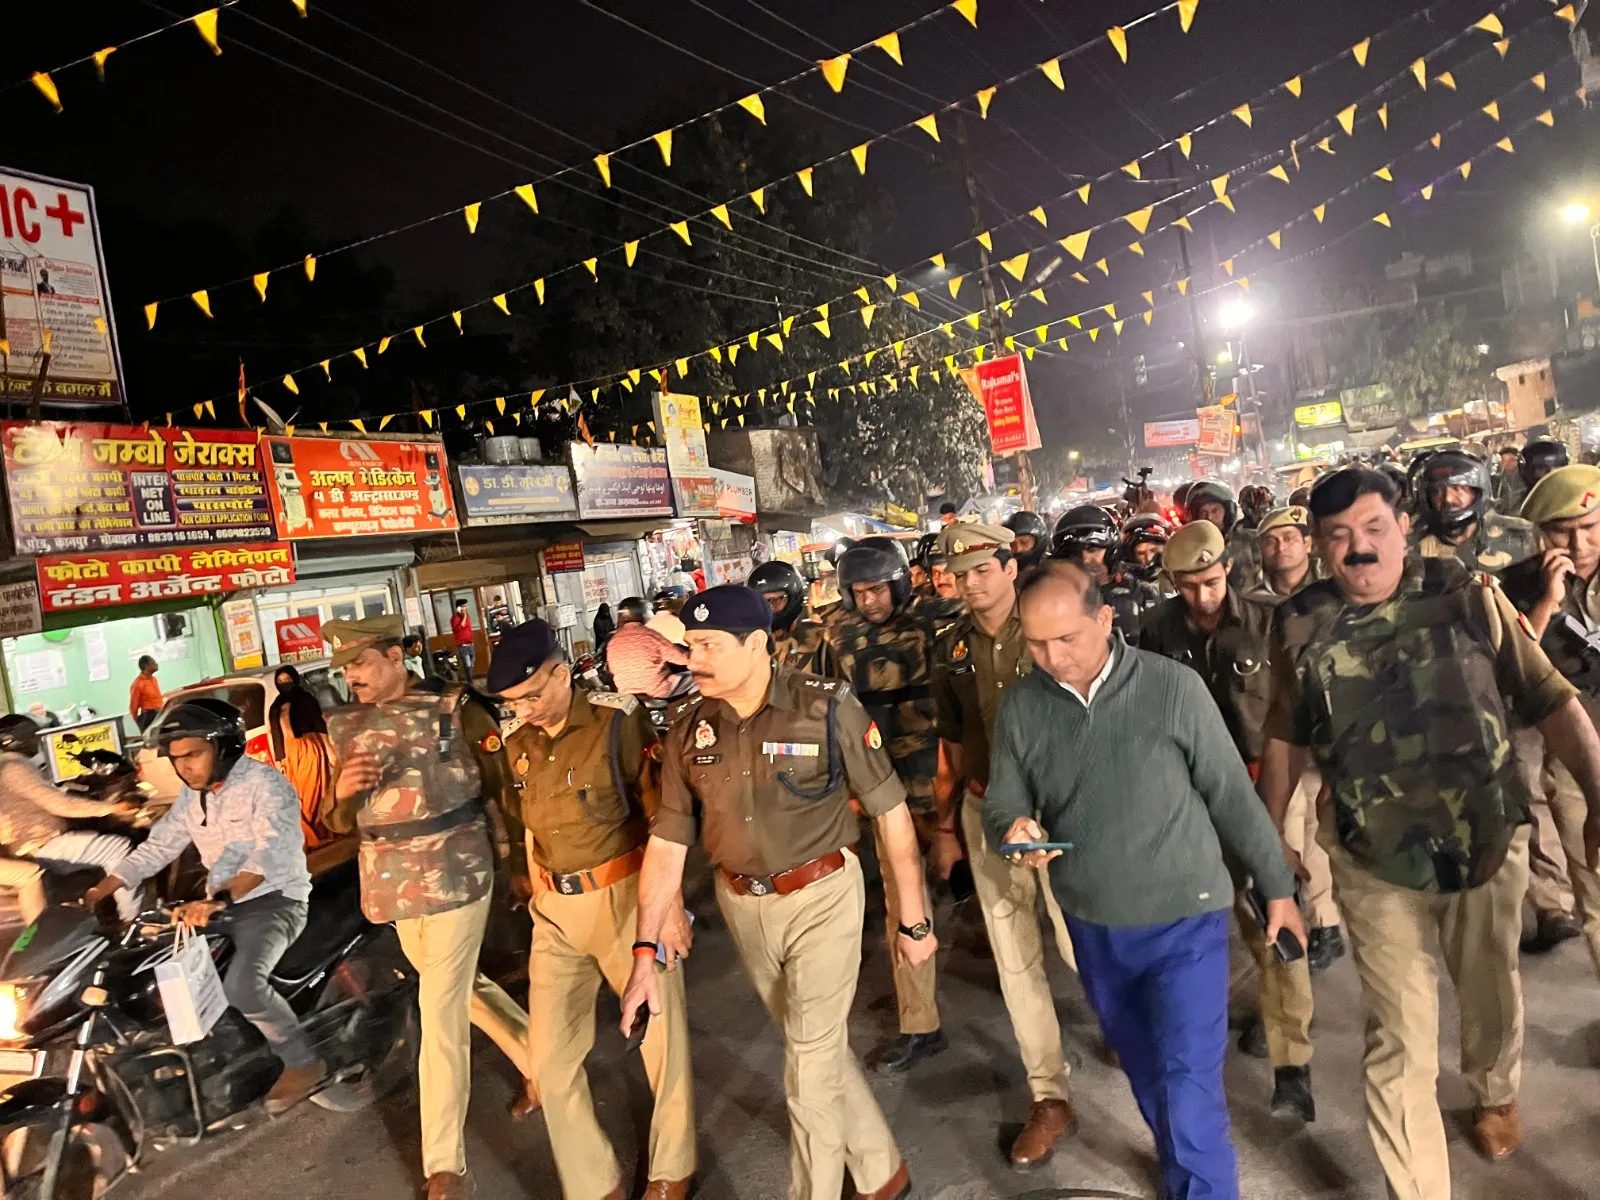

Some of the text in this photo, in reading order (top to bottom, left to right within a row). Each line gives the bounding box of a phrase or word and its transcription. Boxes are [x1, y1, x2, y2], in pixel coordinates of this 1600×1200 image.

[981, 371, 1020, 390] Rajkamal's
[92, 430, 167, 464] जम्बो
[173, 431, 257, 466] जेराक्स
[132, 475, 169, 486] INTER
[310, 470, 355, 487] अल्फा
[141, 487, 164, 499] NET
[328, 488, 345, 503] डी
[726, 483, 752, 496] PLUMBER
[146, 500, 164, 511] ON
[143, 511, 171, 523] LINE
[181, 515, 194, 525] PAN
[195, 514, 211, 524] CARD
[217, 513, 253, 523] APPLICATION
[44, 547, 288, 582] फोटो कापी लैमिनेशन
[48, 567, 291, 607] टंडन अर्जेन्ट फोटो
